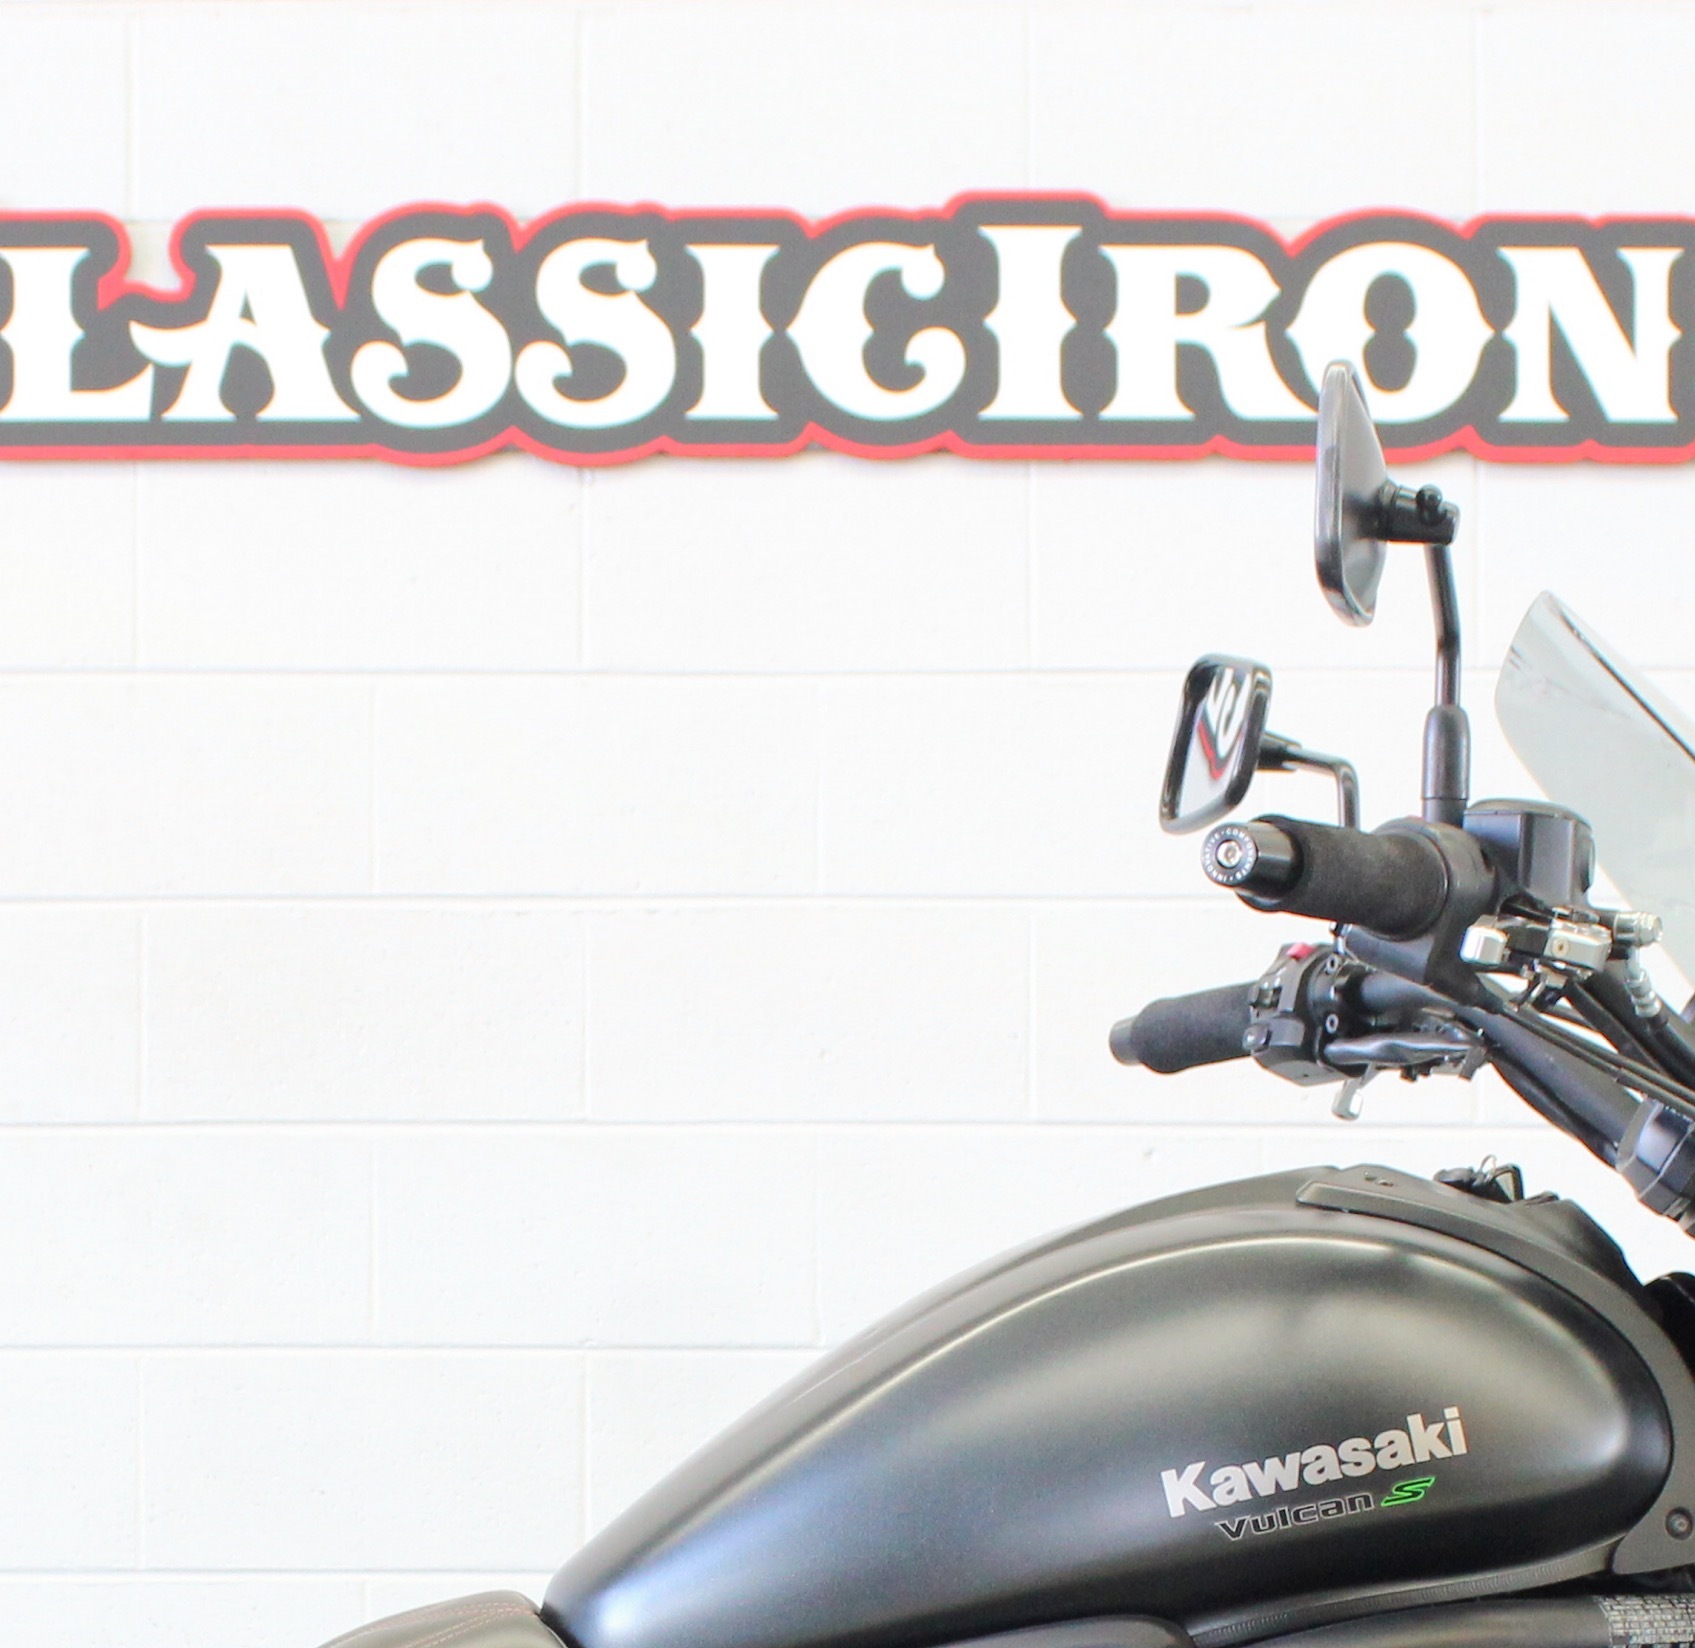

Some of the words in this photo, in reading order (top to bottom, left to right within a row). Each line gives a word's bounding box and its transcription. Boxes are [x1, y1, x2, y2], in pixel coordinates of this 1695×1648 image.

[1160, 1405, 1468, 1519] Kawasaki
[1215, 1491, 1375, 1541] Vulcan
[1380, 1476, 1437, 1508] S
